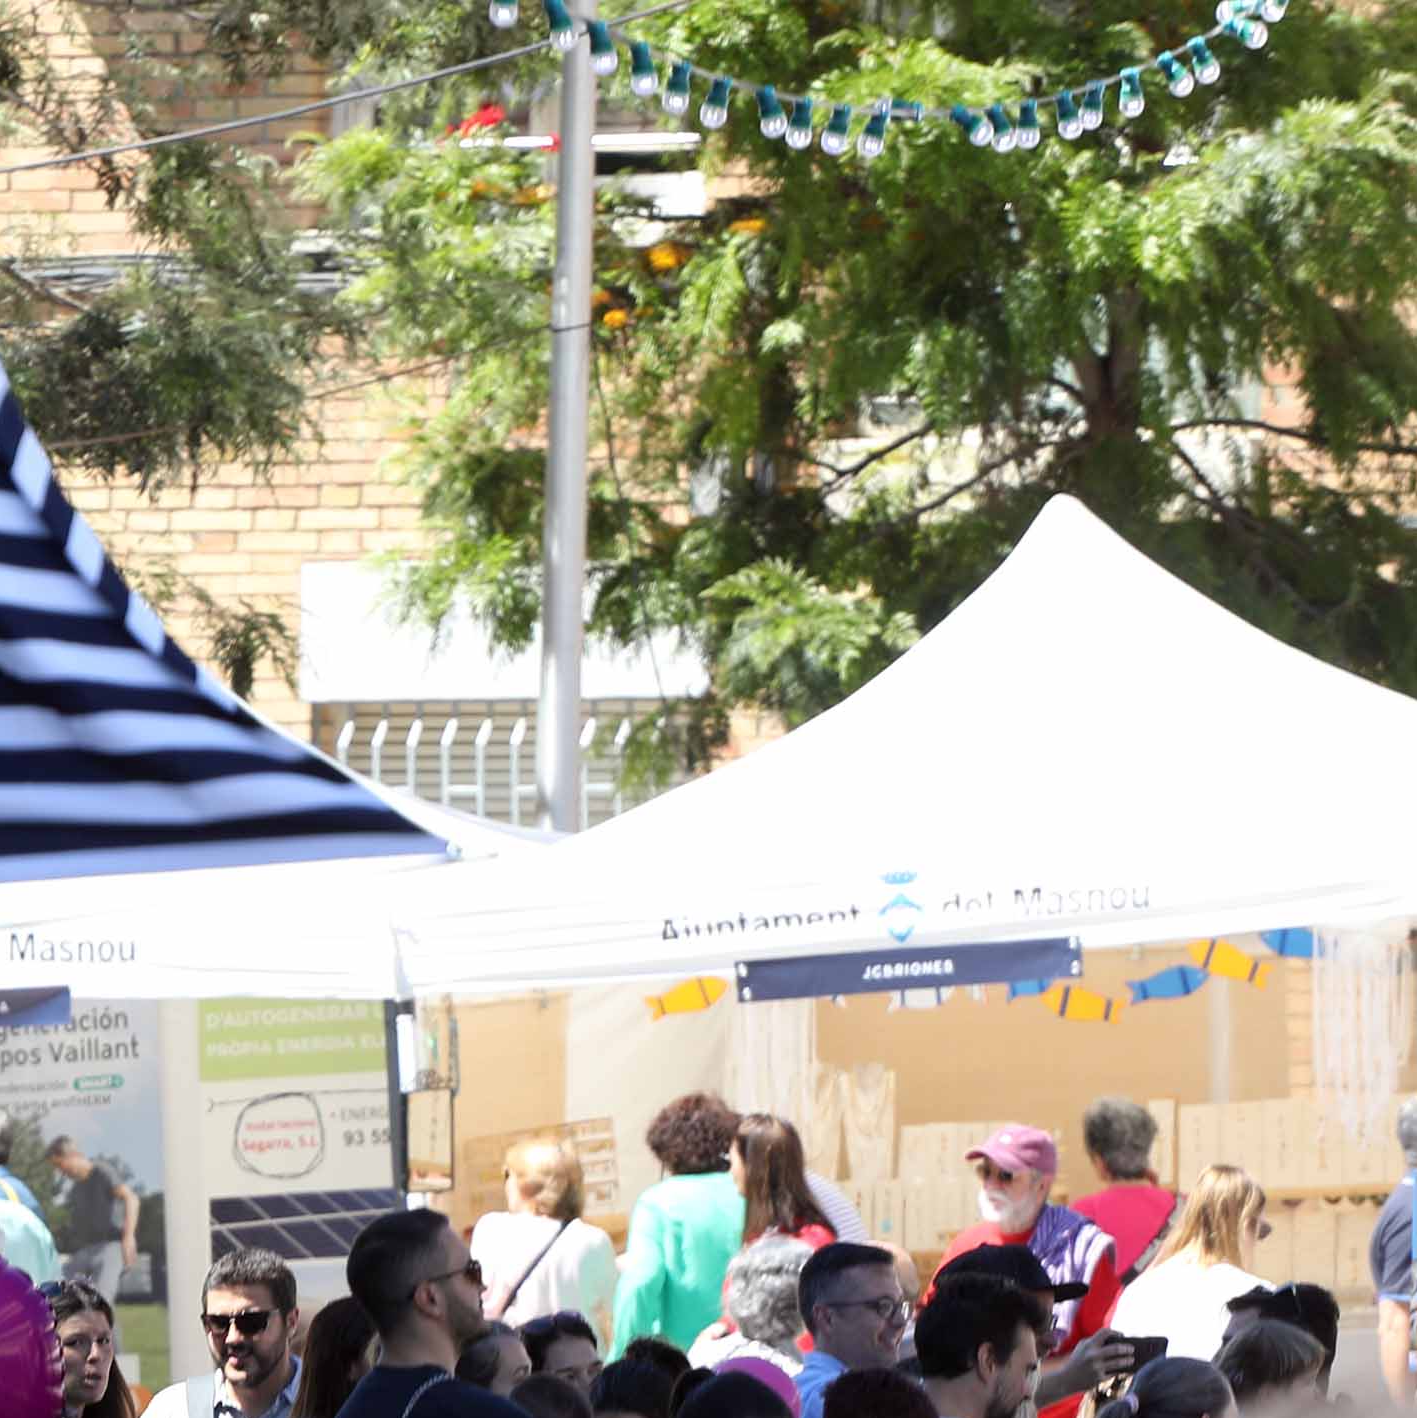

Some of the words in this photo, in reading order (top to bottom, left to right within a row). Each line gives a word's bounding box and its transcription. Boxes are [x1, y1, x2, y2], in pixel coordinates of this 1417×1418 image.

[9, 931, 137, 964] Masnou
[862, 958, 955, 981] JCBRIONES
[47, 1034, 141, 1064] Vaillant
